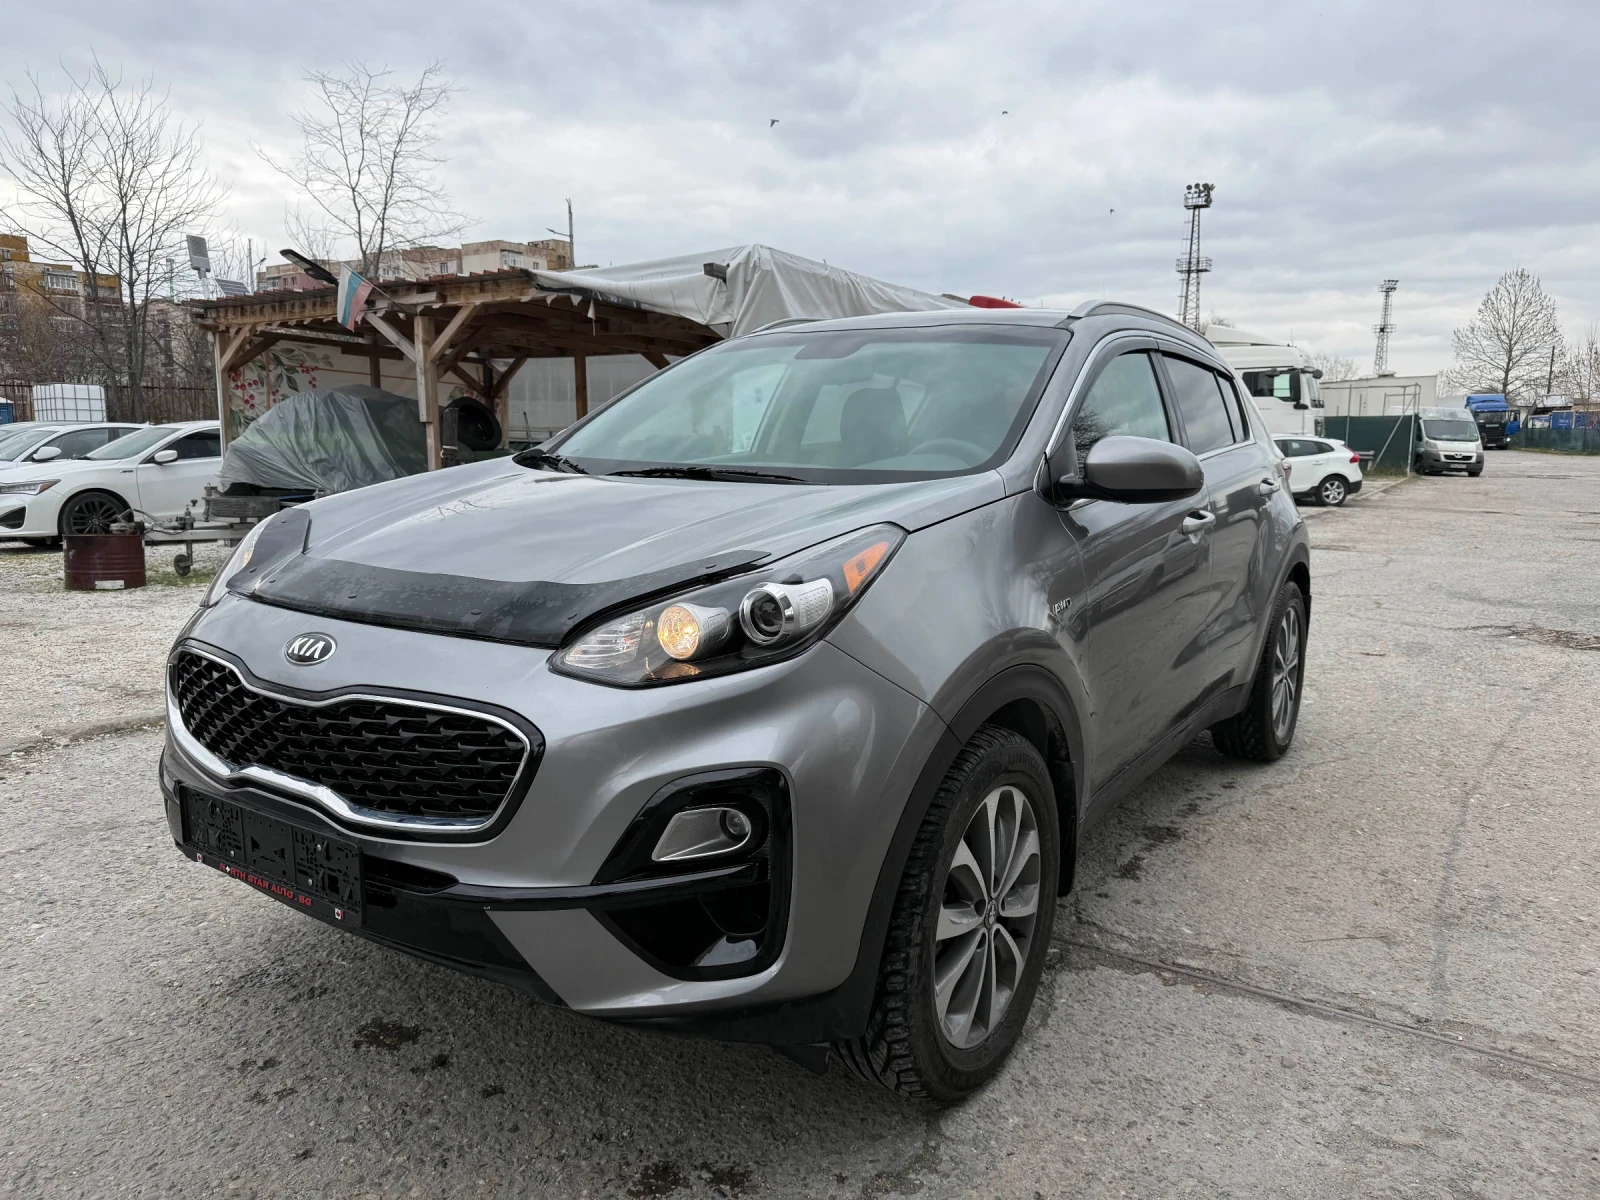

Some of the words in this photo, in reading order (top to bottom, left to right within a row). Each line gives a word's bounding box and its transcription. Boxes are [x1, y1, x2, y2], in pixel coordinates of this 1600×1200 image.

[288, 637, 326, 659] KIA
[219, 863, 246, 880] NRTH
[248, 875, 269, 889] STAR
[271, 885, 294, 899] AUTO
